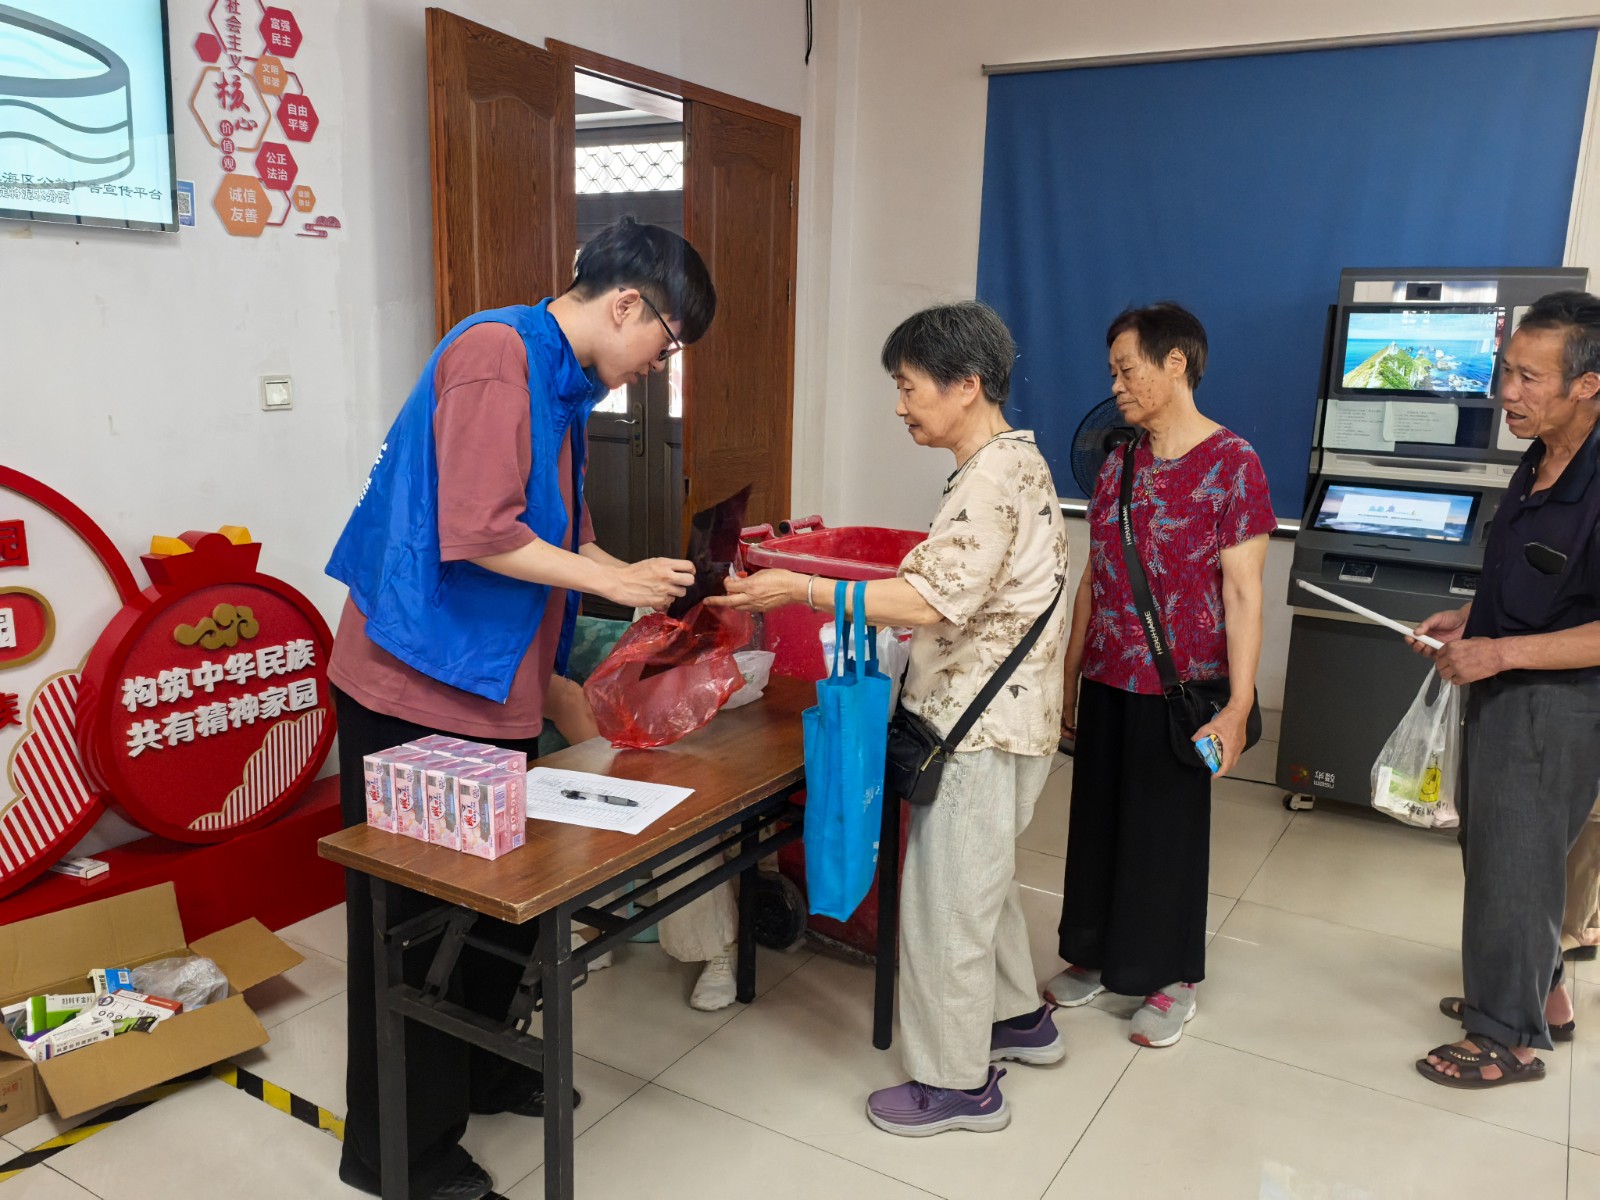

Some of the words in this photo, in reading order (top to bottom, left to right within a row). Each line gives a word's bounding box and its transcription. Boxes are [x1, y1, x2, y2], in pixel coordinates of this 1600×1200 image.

[270, 17, 291, 33] 富强
[226, 0, 243, 73] 社会主义
[271, 32, 292, 48] 民主
[261, 63, 279, 75] 文明
[262, 76, 280, 88] 和谐
[287, 103, 308, 117] 自由
[288, 118, 309, 133] 平等
[220, 121, 236, 171] 价值观
[266, 151, 287, 166] 公正
[266, 167, 288, 182] 法治
[0, 172, 163, 200] 海区公益广告宣传平台
[229, 187, 257, 204] 诚信
[230, 206, 258, 224] 友善
[122, 638, 316, 713] 构筑中华民族
[126, 677, 319, 758] 共有精神家园
